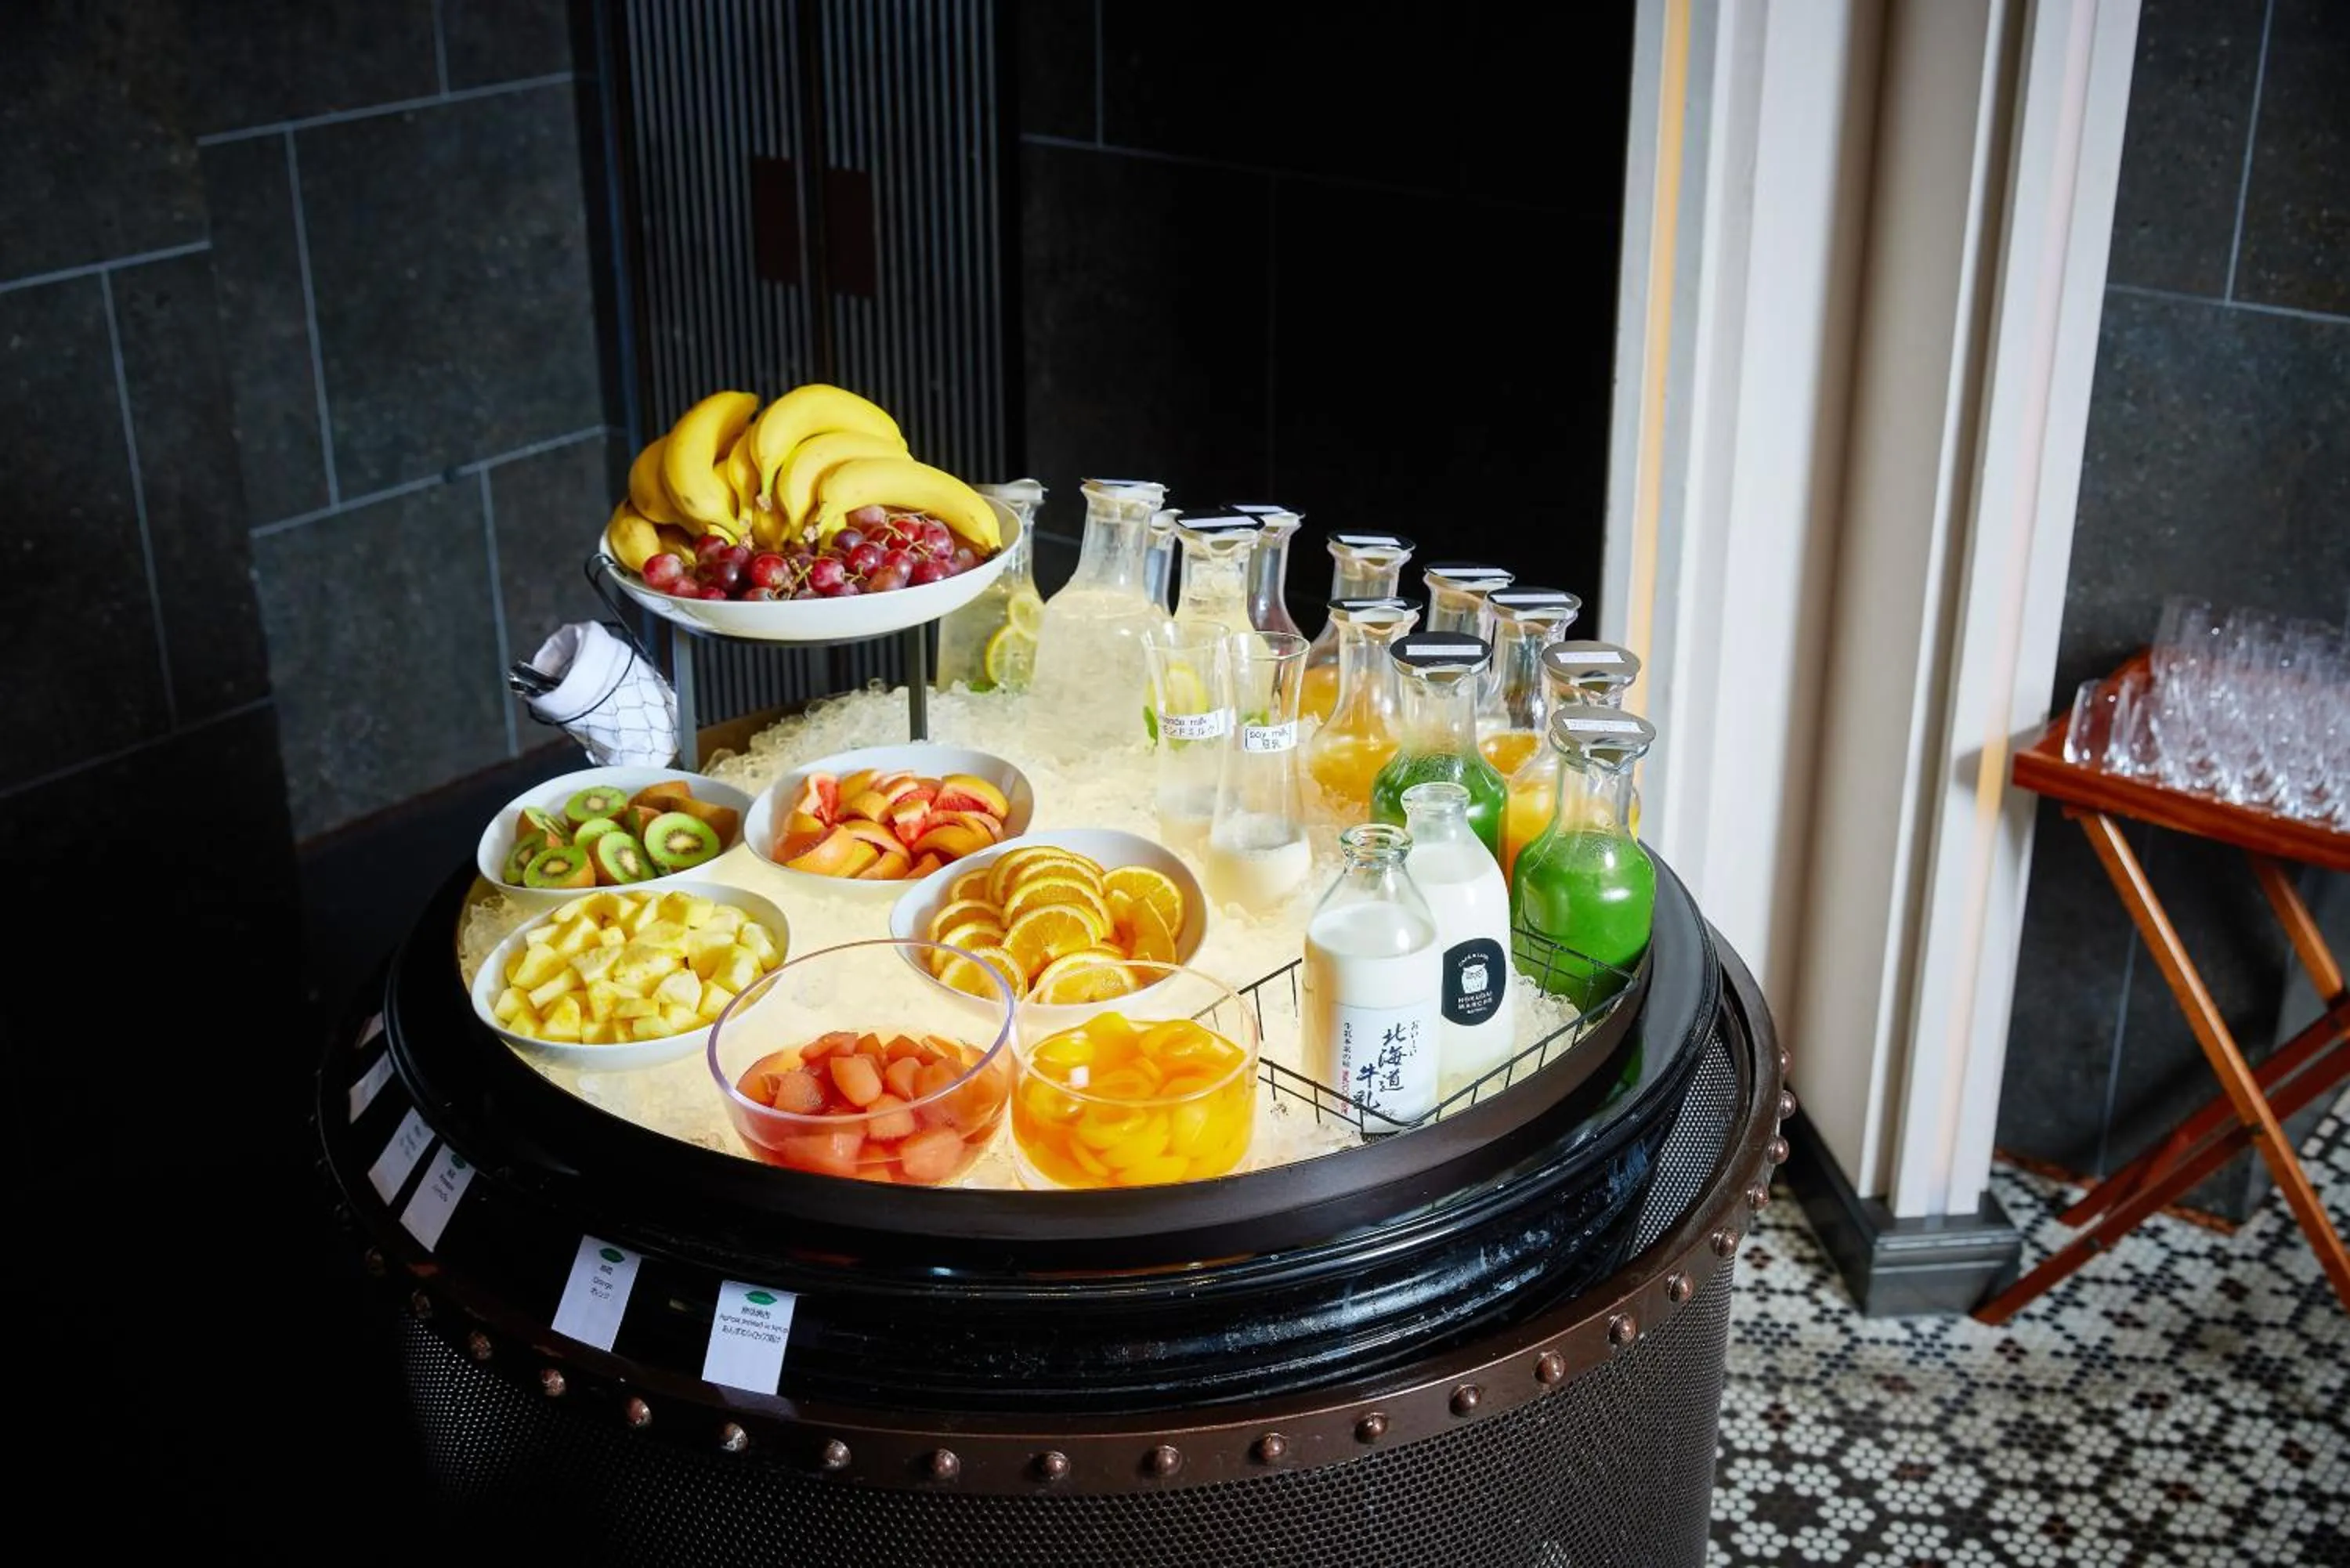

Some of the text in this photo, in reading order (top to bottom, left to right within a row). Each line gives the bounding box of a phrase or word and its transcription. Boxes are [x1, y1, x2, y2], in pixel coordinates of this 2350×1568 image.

[1249, 728, 1289, 742] soy milk
[1378, 1023, 1408, 1093] 北海道
[1353, 1063, 1381, 1111] 牛乳
